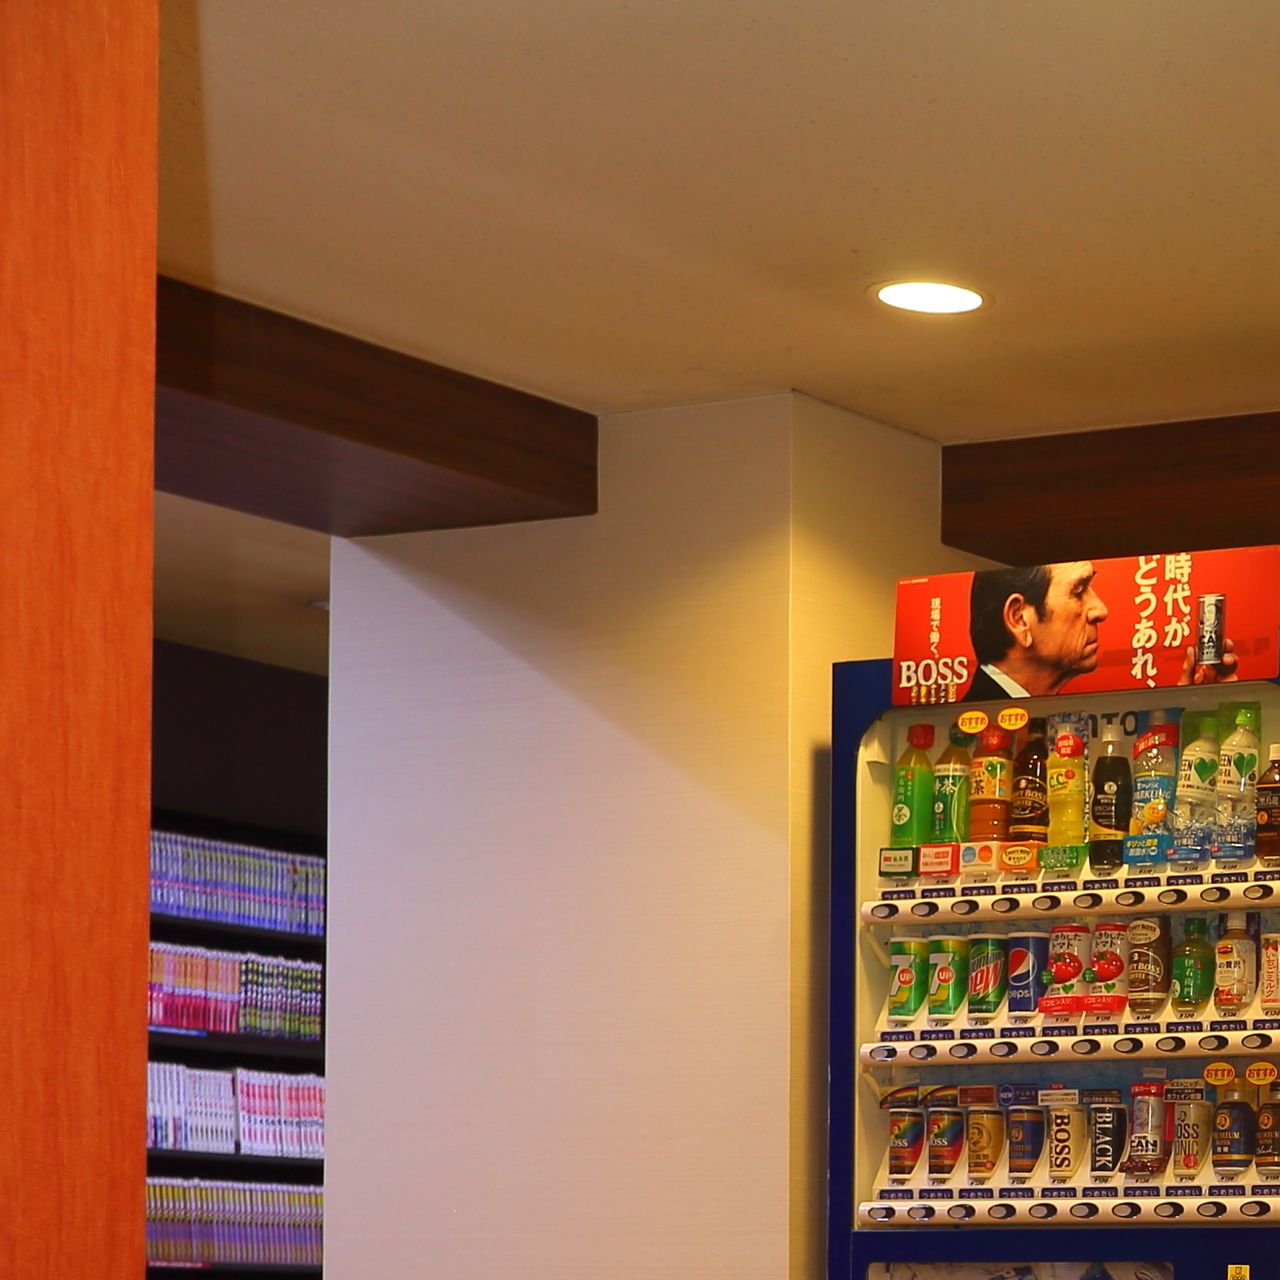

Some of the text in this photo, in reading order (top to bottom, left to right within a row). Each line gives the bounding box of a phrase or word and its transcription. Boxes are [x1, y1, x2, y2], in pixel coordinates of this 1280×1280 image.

[1131, 555, 1161, 689] どうあれ、
[1163, 553, 1192, 647] 時代が
[899, 657, 968, 688] BOSS
[1054, 1113, 1071, 1169] BOSS
[1095, 1112, 1113, 1168] BLACK
